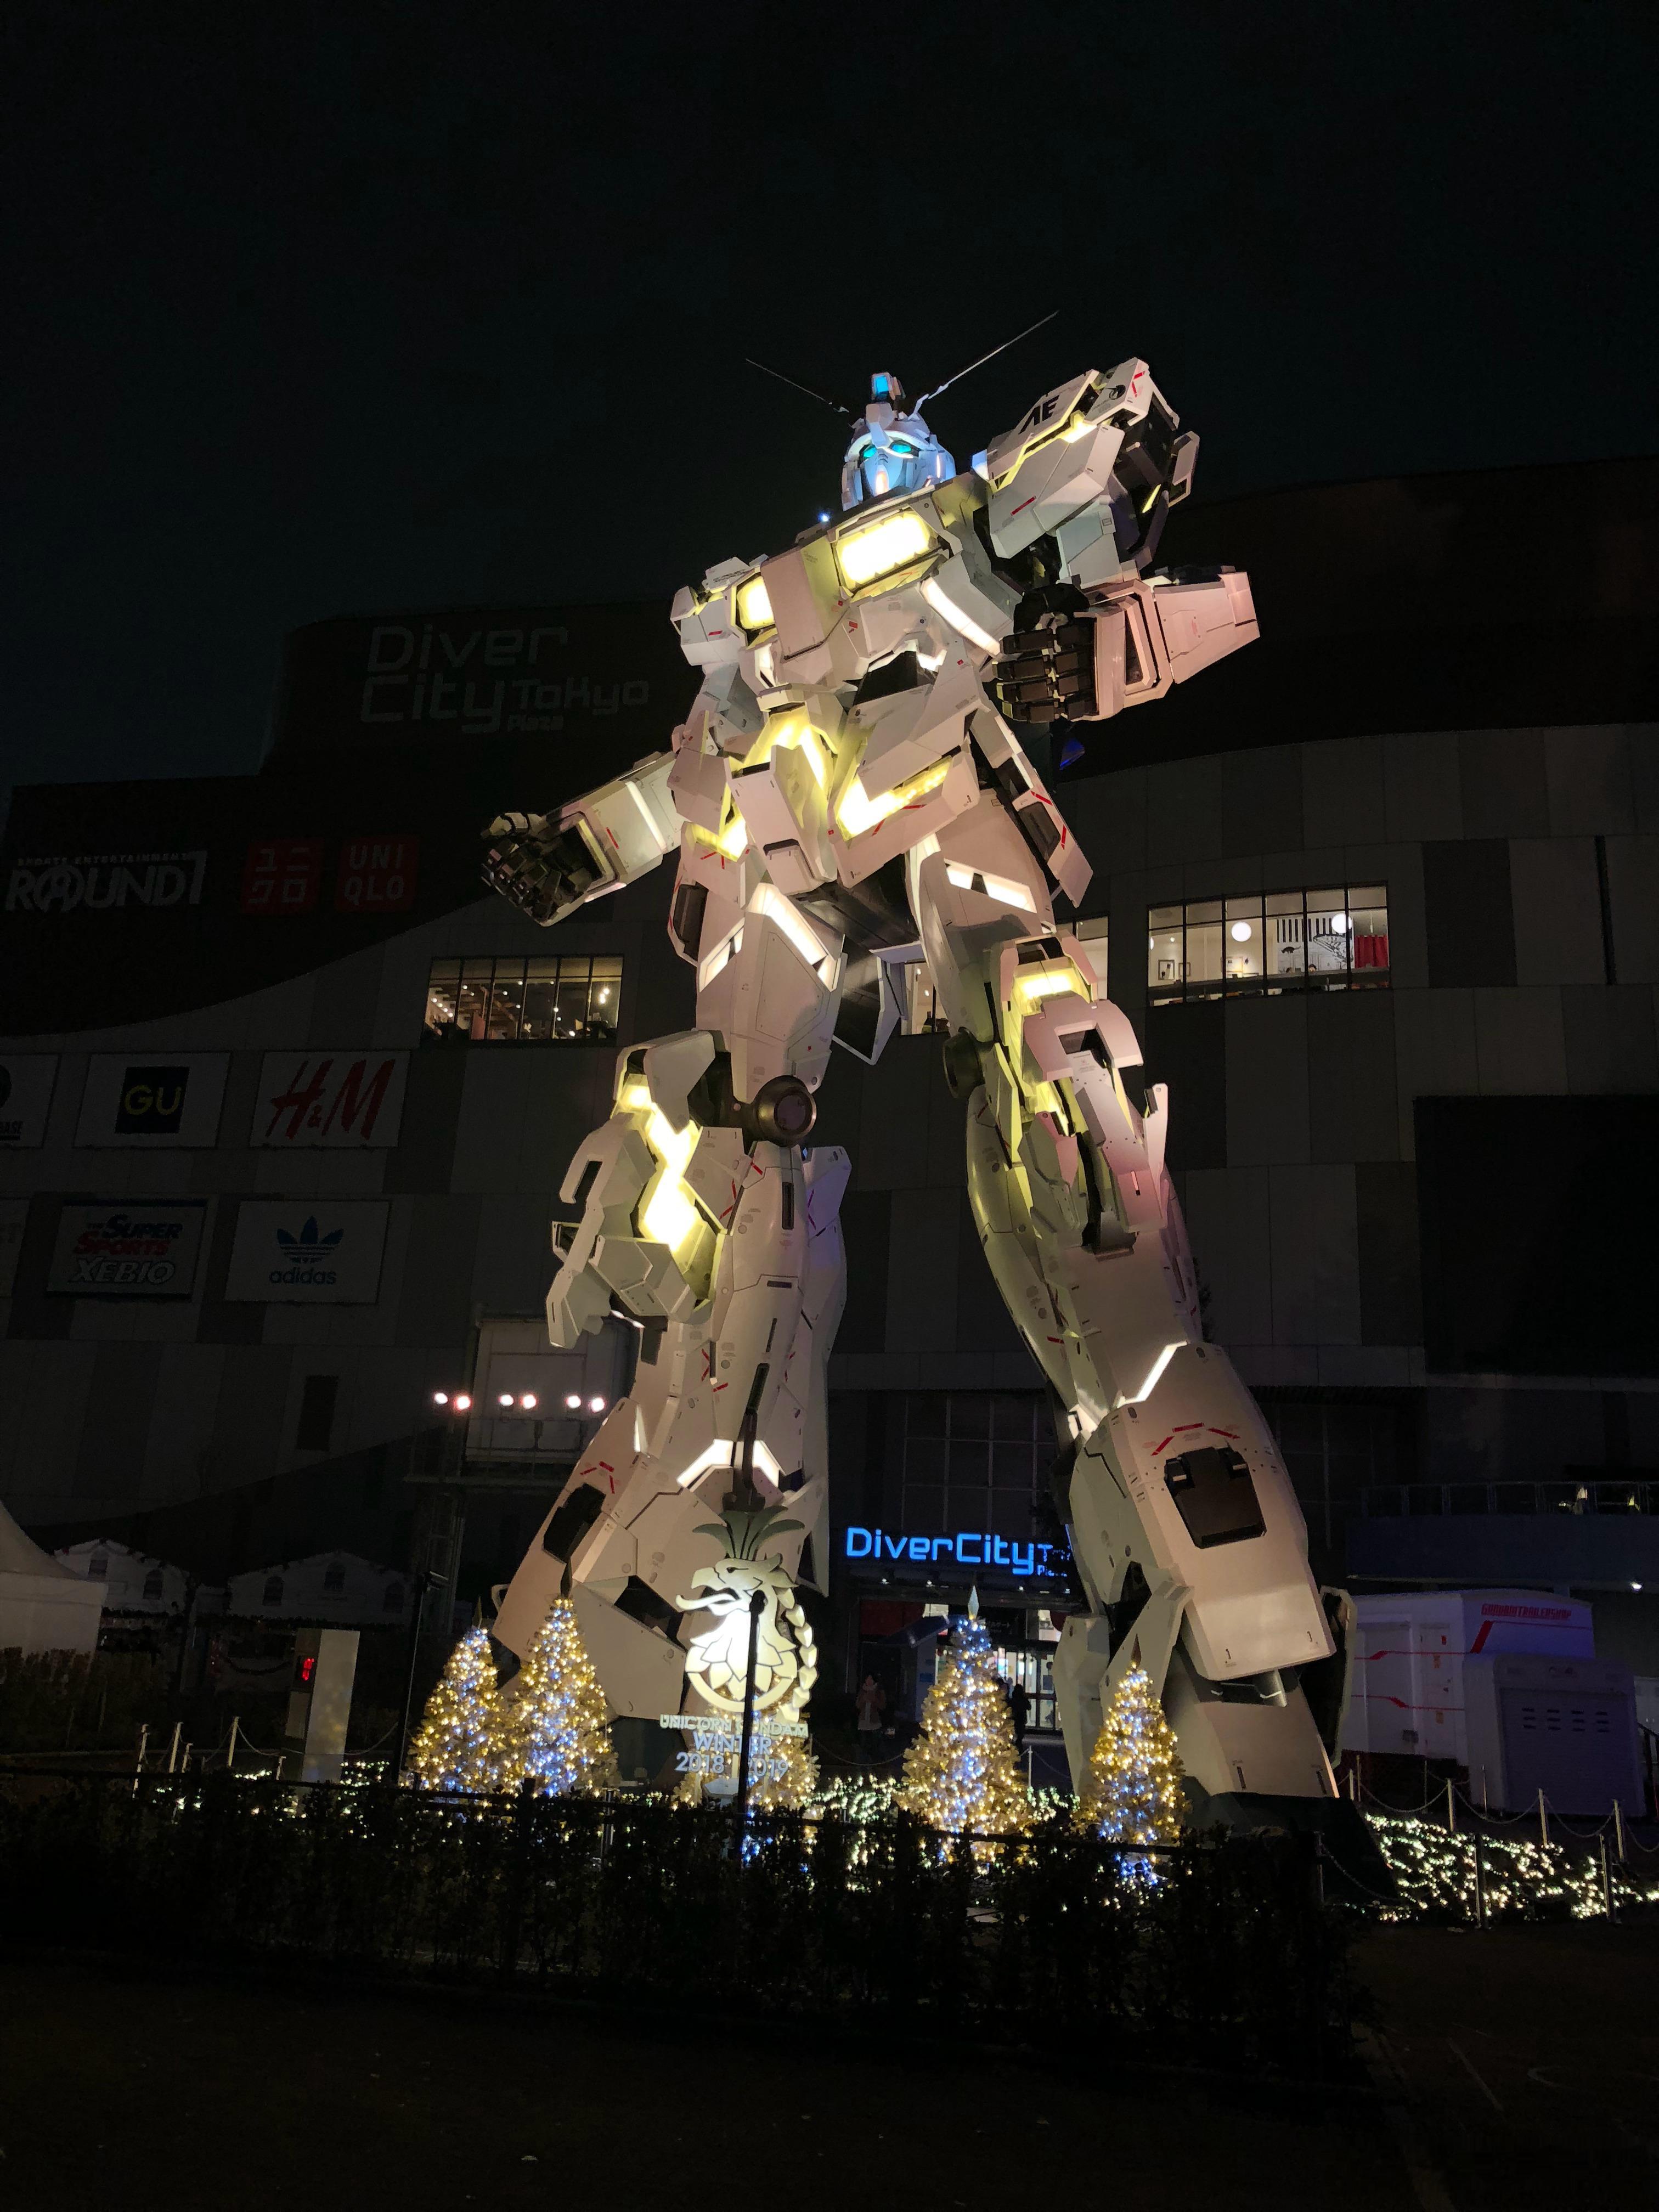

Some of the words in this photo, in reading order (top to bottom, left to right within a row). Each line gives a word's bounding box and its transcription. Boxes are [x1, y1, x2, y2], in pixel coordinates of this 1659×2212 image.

[366, 623, 569, 673] Diver
[360, 672, 505, 734] City
[512, 676, 649, 715] Tokyo
[349, 843, 403, 870] UNI
[343, 874, 404, 905] QLO
[123, 1085, 182, 1115] GU
[265, 1059, 395, 1140] H&M
[69, 1256, 176, 1285] XEBIO
[269, 1269, 337, 1285] adidas
[847, 1527, 1034, 1575] DiverCity
[659, 1714, 732, 1731] UNICORN
[675, 1752, 724, 1774] 2018
